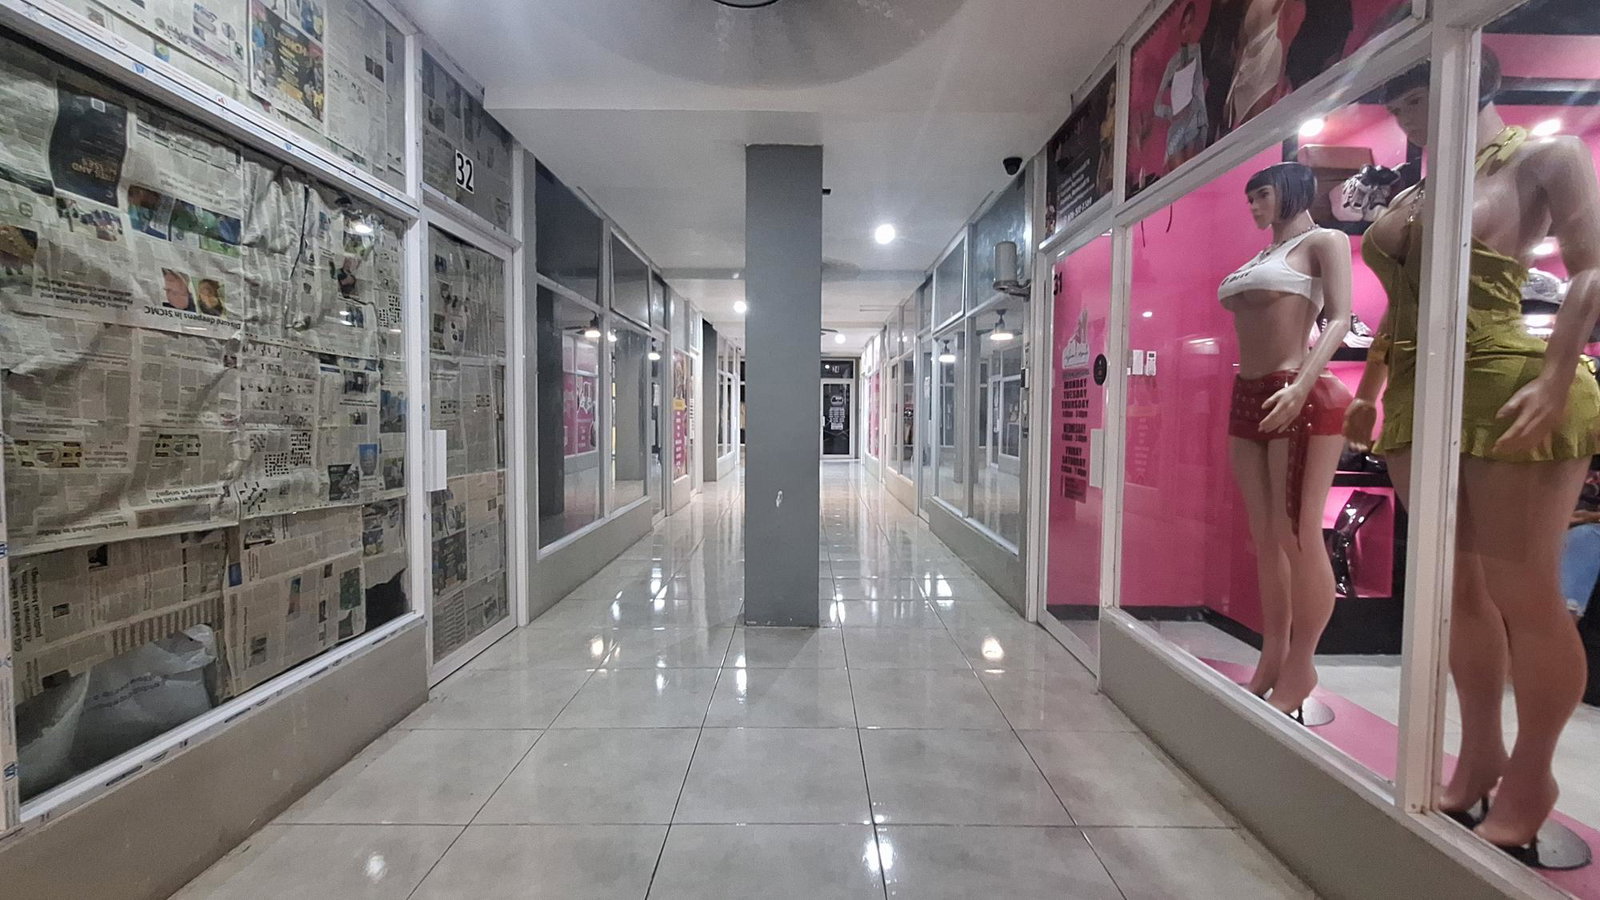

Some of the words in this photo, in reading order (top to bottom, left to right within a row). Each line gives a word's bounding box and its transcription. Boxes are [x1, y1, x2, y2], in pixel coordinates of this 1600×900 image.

[457, 152, 473, 192] 32
[1053, 271, 1063, 296] 31
[144, 306, 173, 317] StCMC
[183, 313, 215, 325] deepens
[216, 318, 241, 330] Discord
[1063, 378, 1087, 389] MONDAY
[1063, 389, 1087, 399] TUESDAY
[1061, 399, 1089, 409] THURSDAY
[1061, 456, 1086, 467] SATURDAY
